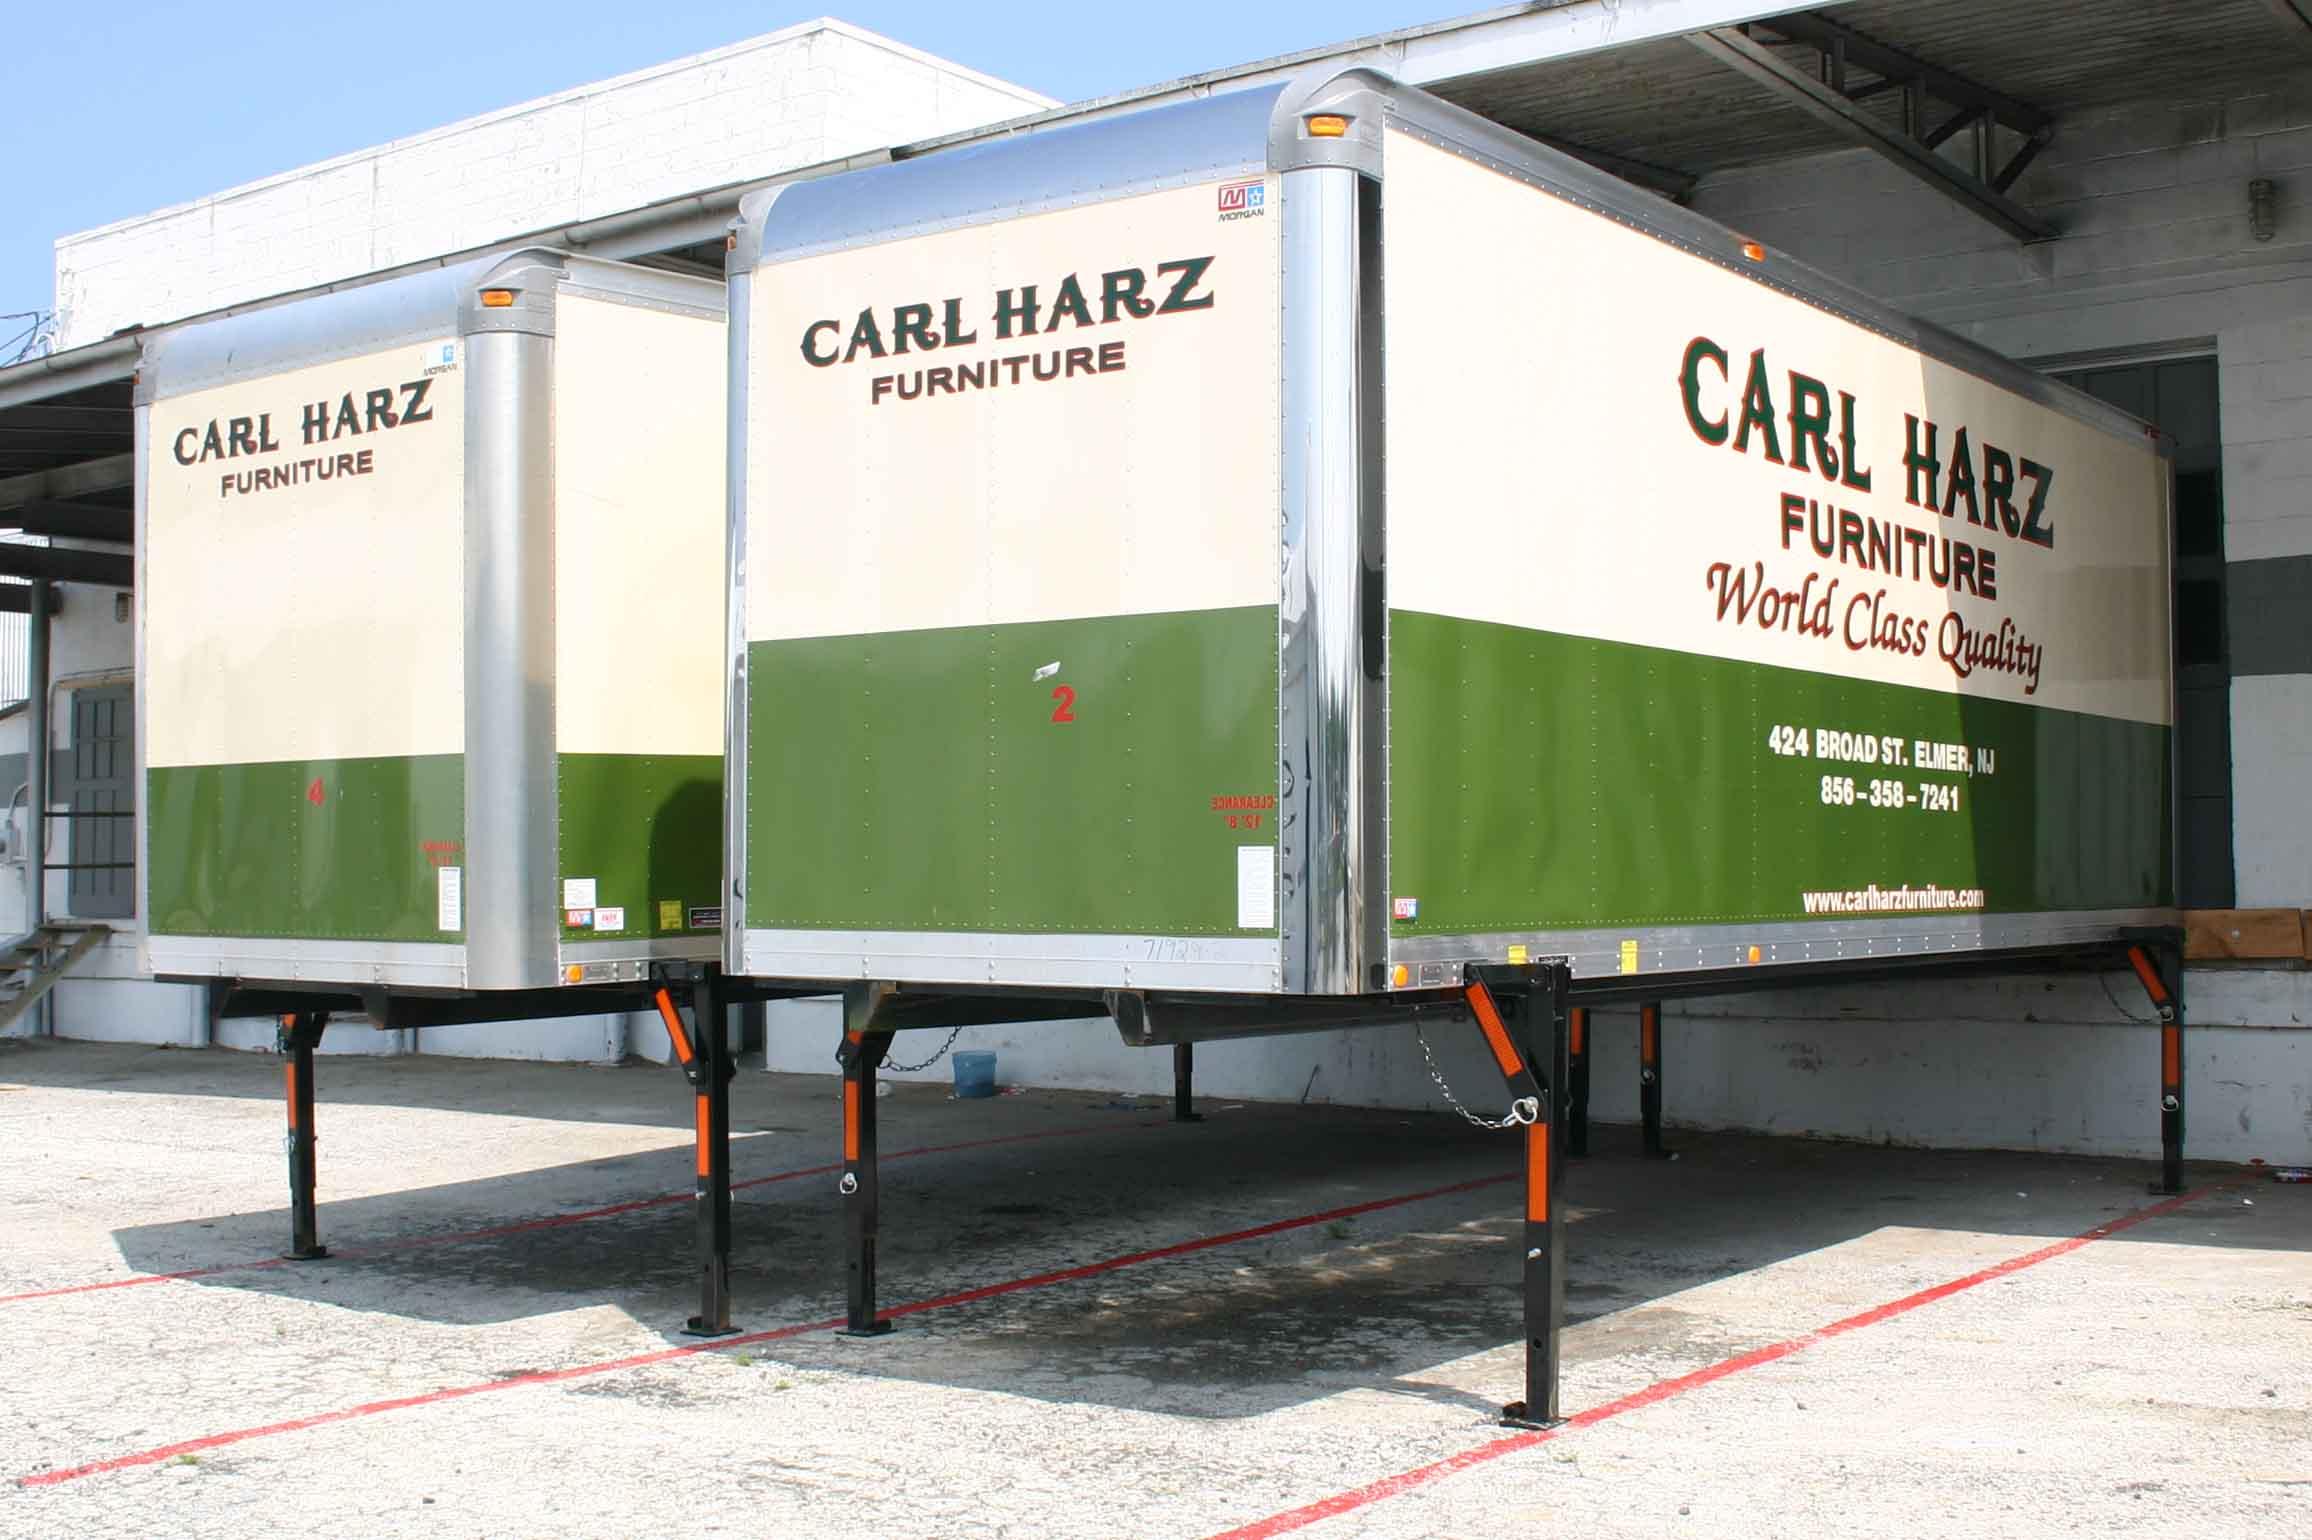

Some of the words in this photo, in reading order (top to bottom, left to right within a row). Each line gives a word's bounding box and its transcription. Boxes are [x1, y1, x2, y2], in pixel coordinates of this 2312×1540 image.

[1218, 207, 1265, 222] MORGAN
[801, 297, 977, 367] CARL
[992, 256, 1216, 339] HARZ
[872, 341, 1126, 405] FURNITURE
[173, 413, 280, 467] CARL
[301, 378, 434, 446] HARZ
[1678, 335, 1871, 494] CARL
[1902, 411, 2055, 549] HARZ
[220, 449, 375, 498] FURNITURE
[1779, 491, 1997, 601] FURNITURE
[1706, 560, 1839, 641] World
[1843, 588, 1929, 657] Class
[1938, 611, 2045, 696] Quality
[1050, 684, 1076, 723] 2
[1768, 724, 1809, 757] 424
[1815, 728, 1878, 763] BROAD
[1881, 736, 1908, 766] ST.
[1914, 740, 1974, 778] ELMER,
[1977, 747, 1996, 774] NJ
[307, 777, 325, 807] 4
[1803, 884, 1985, 913] www.carlharzfurniture.com
